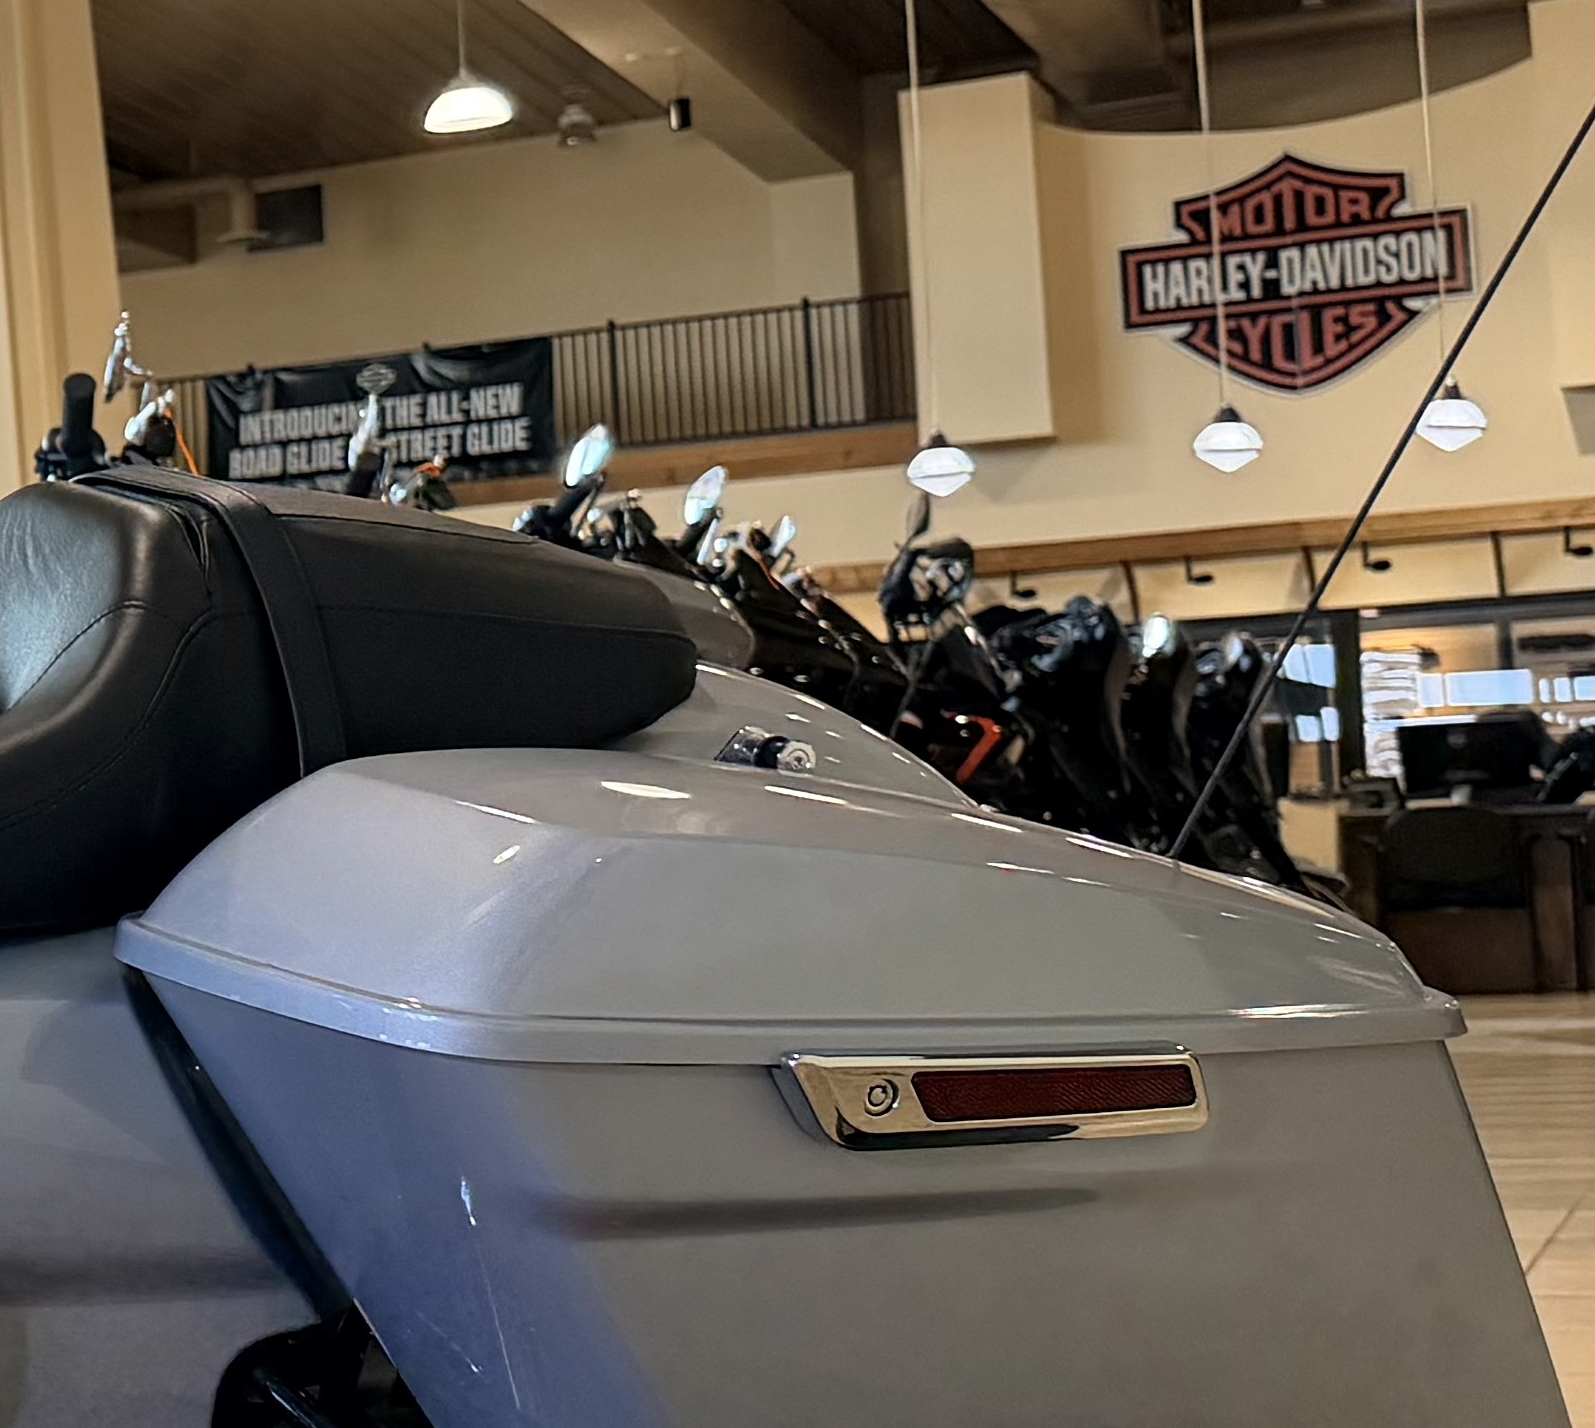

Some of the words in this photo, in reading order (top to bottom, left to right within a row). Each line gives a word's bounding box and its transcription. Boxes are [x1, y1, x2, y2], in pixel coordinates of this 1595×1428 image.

[1218, 176, 1373, 239] MOTOR
[1141, 228, 1449, 313] HARLEY-DAVIDSON
[1222, 299, 1379, 372] CYCLES
[239, 401, 364, 446] INTRODUCIN
[384, 393, 425, 429] THE
[426, 382, 524, 422] ALL-NEW
[229, 444, 284, 479] ROAD
[286, 436, 347, 474] GLIDE
[466, 416, 533, 456] GLIDE
